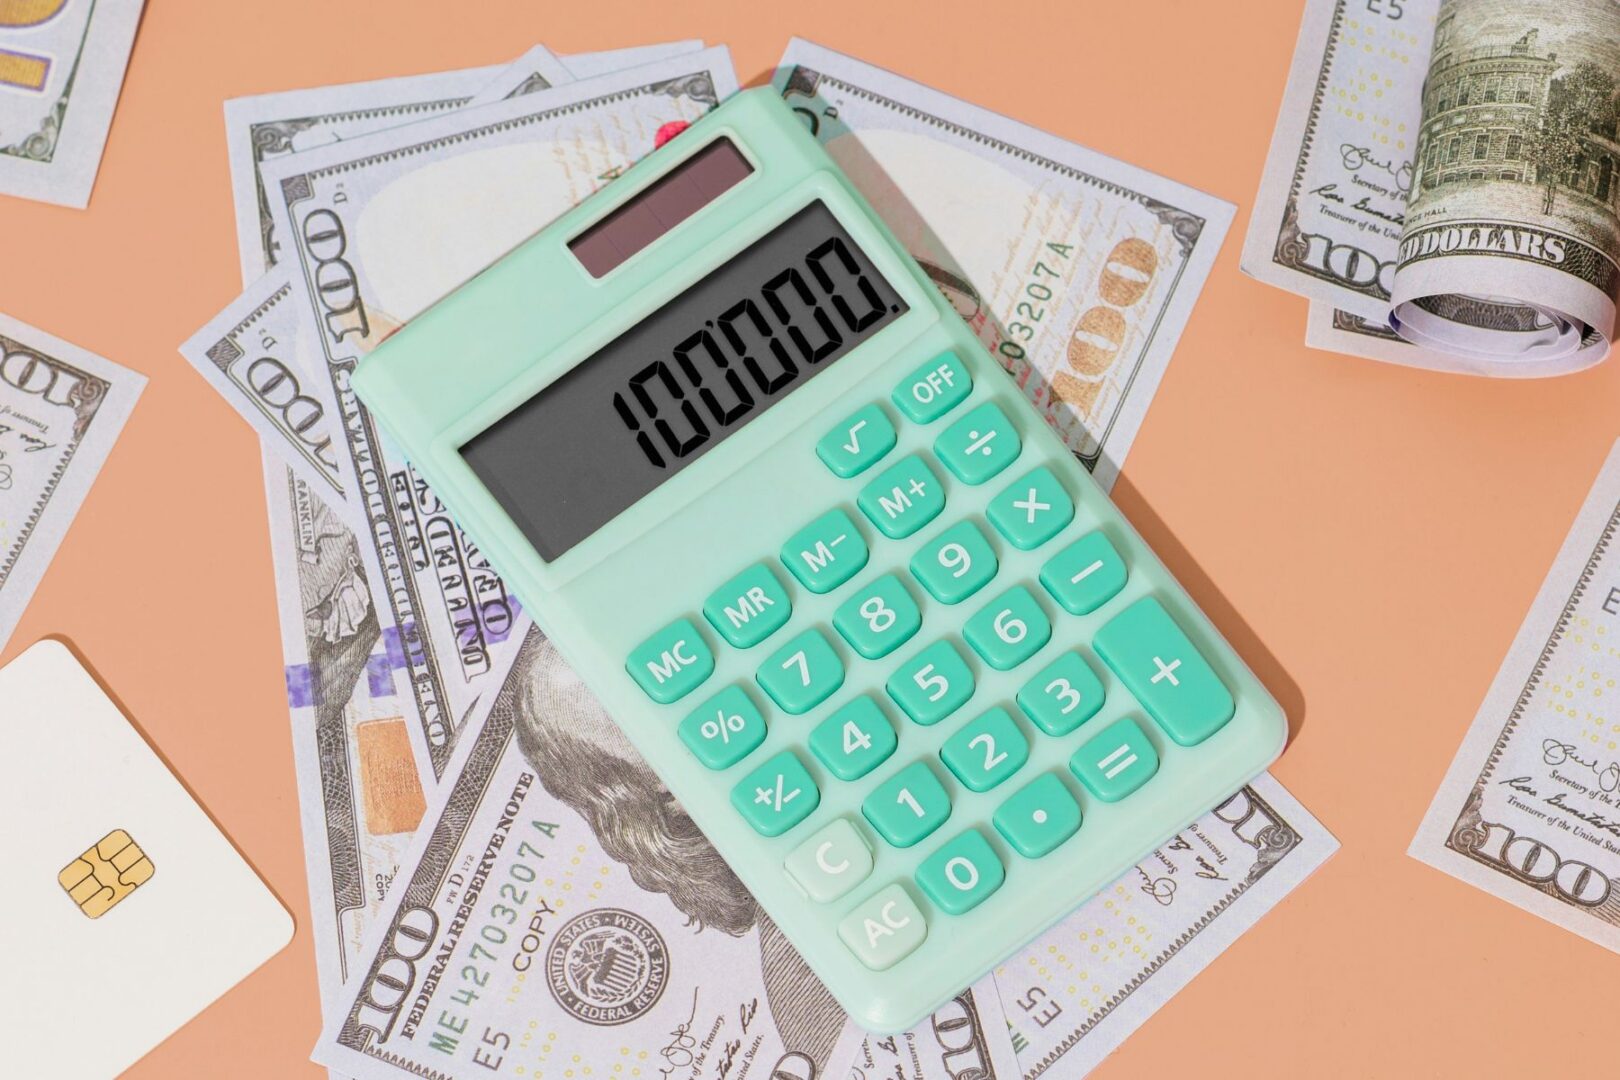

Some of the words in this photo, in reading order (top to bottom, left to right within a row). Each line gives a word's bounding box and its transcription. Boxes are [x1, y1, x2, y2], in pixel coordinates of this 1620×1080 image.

[1351, 174, 1388, 196] Secretary
[1319, 204, 1357, 226] Treasurer
[1422, 227, 1566, 264] DOLLARS
[303, 208, 370, 343] 100
[999, 262, 1062, 376] 03207
[1050, 237, 1158, 423] 100
[1, 351, 77, 408] 10
[912, 364, 955, 403] OFF
[296, 479, 314, 547] RANKLIN
[878, 479, 926, 519] M+
[937, 543, 971, 578] 9
[425, 515, 492, 684] UNITED
[723, 586, 775, 629] MR
[859, 596, 896, 633] 8
[993, 608, 1028, 644] 6
[646, 640, 698, 684] MC
[781, 650, 811, 687] 7
[912, 663, 949, 702] 5
[1044, 678, 1081, 715] 3
[700, 709, 746, 744] %
[841, 720, 873, 755] 4
[967, 733, 1009, 771] 2
[896, 788, 926, 819] 1
[1549, 769, 1588, 797] Secretary
[1589, 789, 1601, 801] of
[1598, 793, 1613, 805] the
[1506, 795, 1547, 820] Treasurer
[1549, 815, 1560, 827] of
[1559, 820, 1571, 832] the
[1573, 825, 1601, 846] United
[1605, 840, 1620, 856] Stat
[815, 841, 849, 875] C
[1153, 851, 1178, 875] Secret
[1195, 831, 1229, 865] Treasurer
[1481, 821, 1612, 907] 100
[375, 874, 386, 902] COPY
[945, 856, 979, 891] 0
[401, 938, 457, 1040] FEDERAL
[447, 833, 507, 940] RESERVE
[496, 772, 535, 834] NOTE
[862, 900, 911, 949] AC
[512, 899, 557, 972] COPY
[615, 915, 660, 952] SYSTEM
[357, 905, 440, 1044] 100
[552, 948, 569, 996] UNITED
[561, 915, 601, 945] STATES
[633, 957, 664, 1010] RESERVE
[573, 1001, 633, 1020] FEDERAL
[1017, 986, 1063, 1028] E5
[472, 1027, 511, 1072] E5
[862, 1039, 875, 1070] Secret
[737, 1062, 751, 1080] nited
